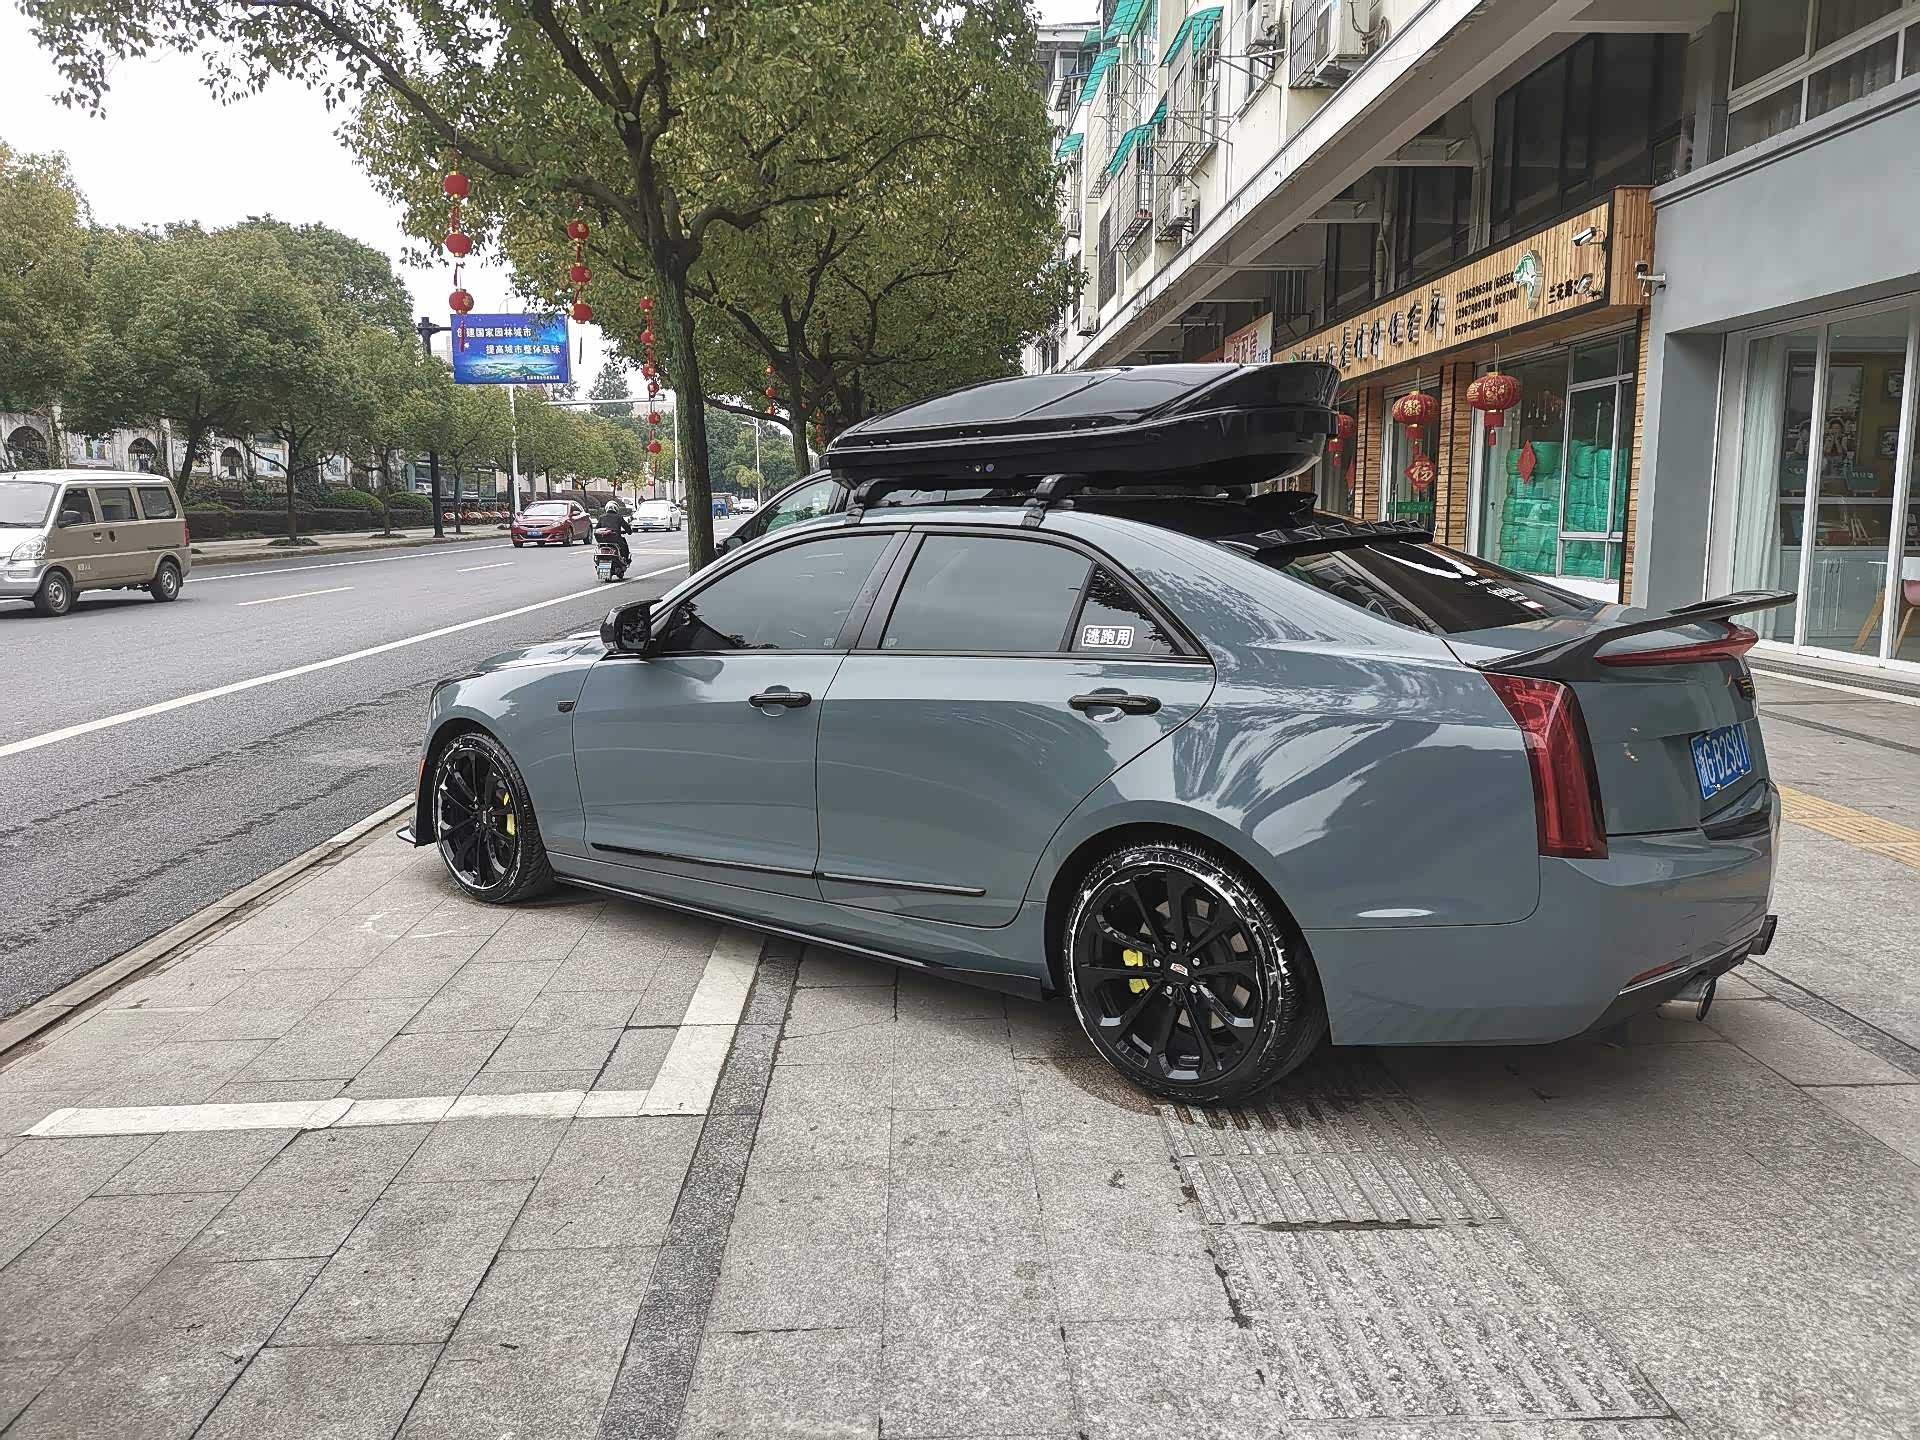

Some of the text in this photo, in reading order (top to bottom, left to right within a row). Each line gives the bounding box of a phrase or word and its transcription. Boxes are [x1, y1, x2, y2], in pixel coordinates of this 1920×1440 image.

[486, 344, 561, 355] 提高城市整体品味
[1085, 629, 1131, 645] 逃跑用
